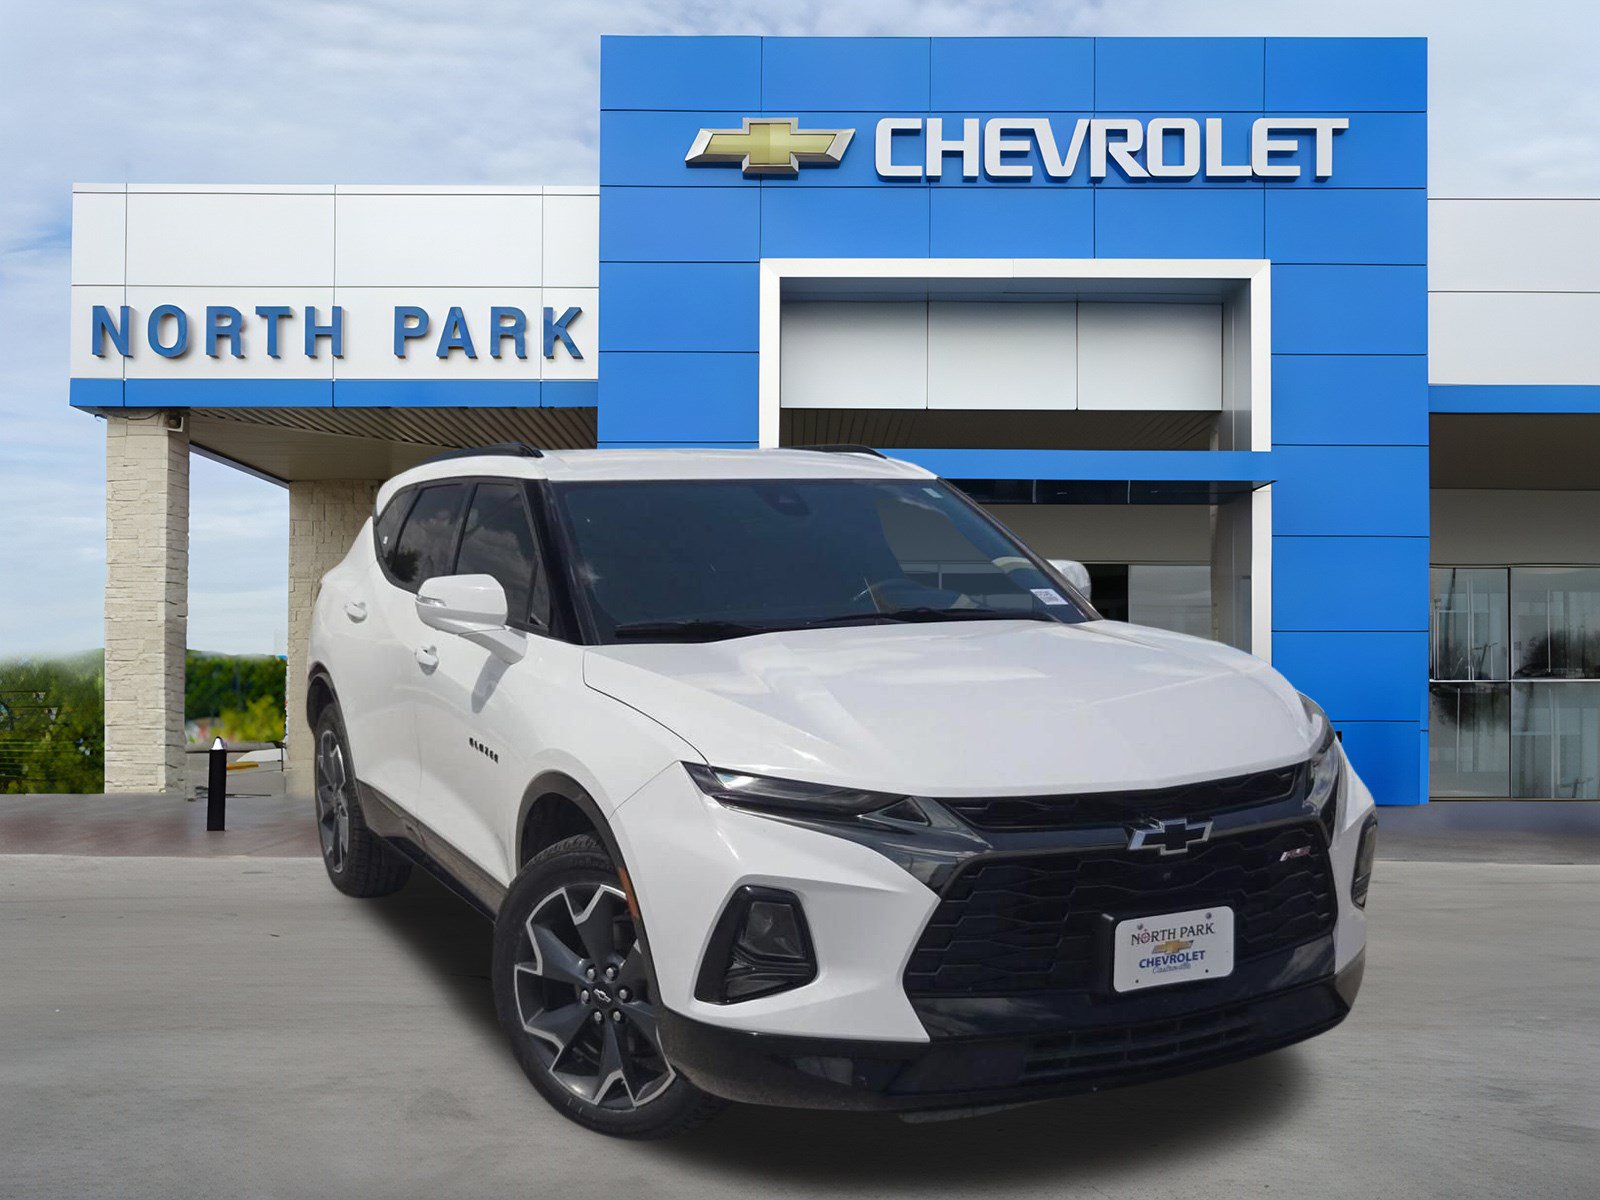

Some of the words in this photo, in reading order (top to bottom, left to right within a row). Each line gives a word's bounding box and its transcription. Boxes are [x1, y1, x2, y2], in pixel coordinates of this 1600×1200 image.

[875, 118, 1350, 178] CHEVROLET
[92, 304, 344, 359] NORTH
[394, 305, 583, 359] PARK
[1131, 928, 1176, 946] NORTH
[1180, 922, 1215, 938] PARK
[1139, 950, 1205, 968] CHEVROLET
